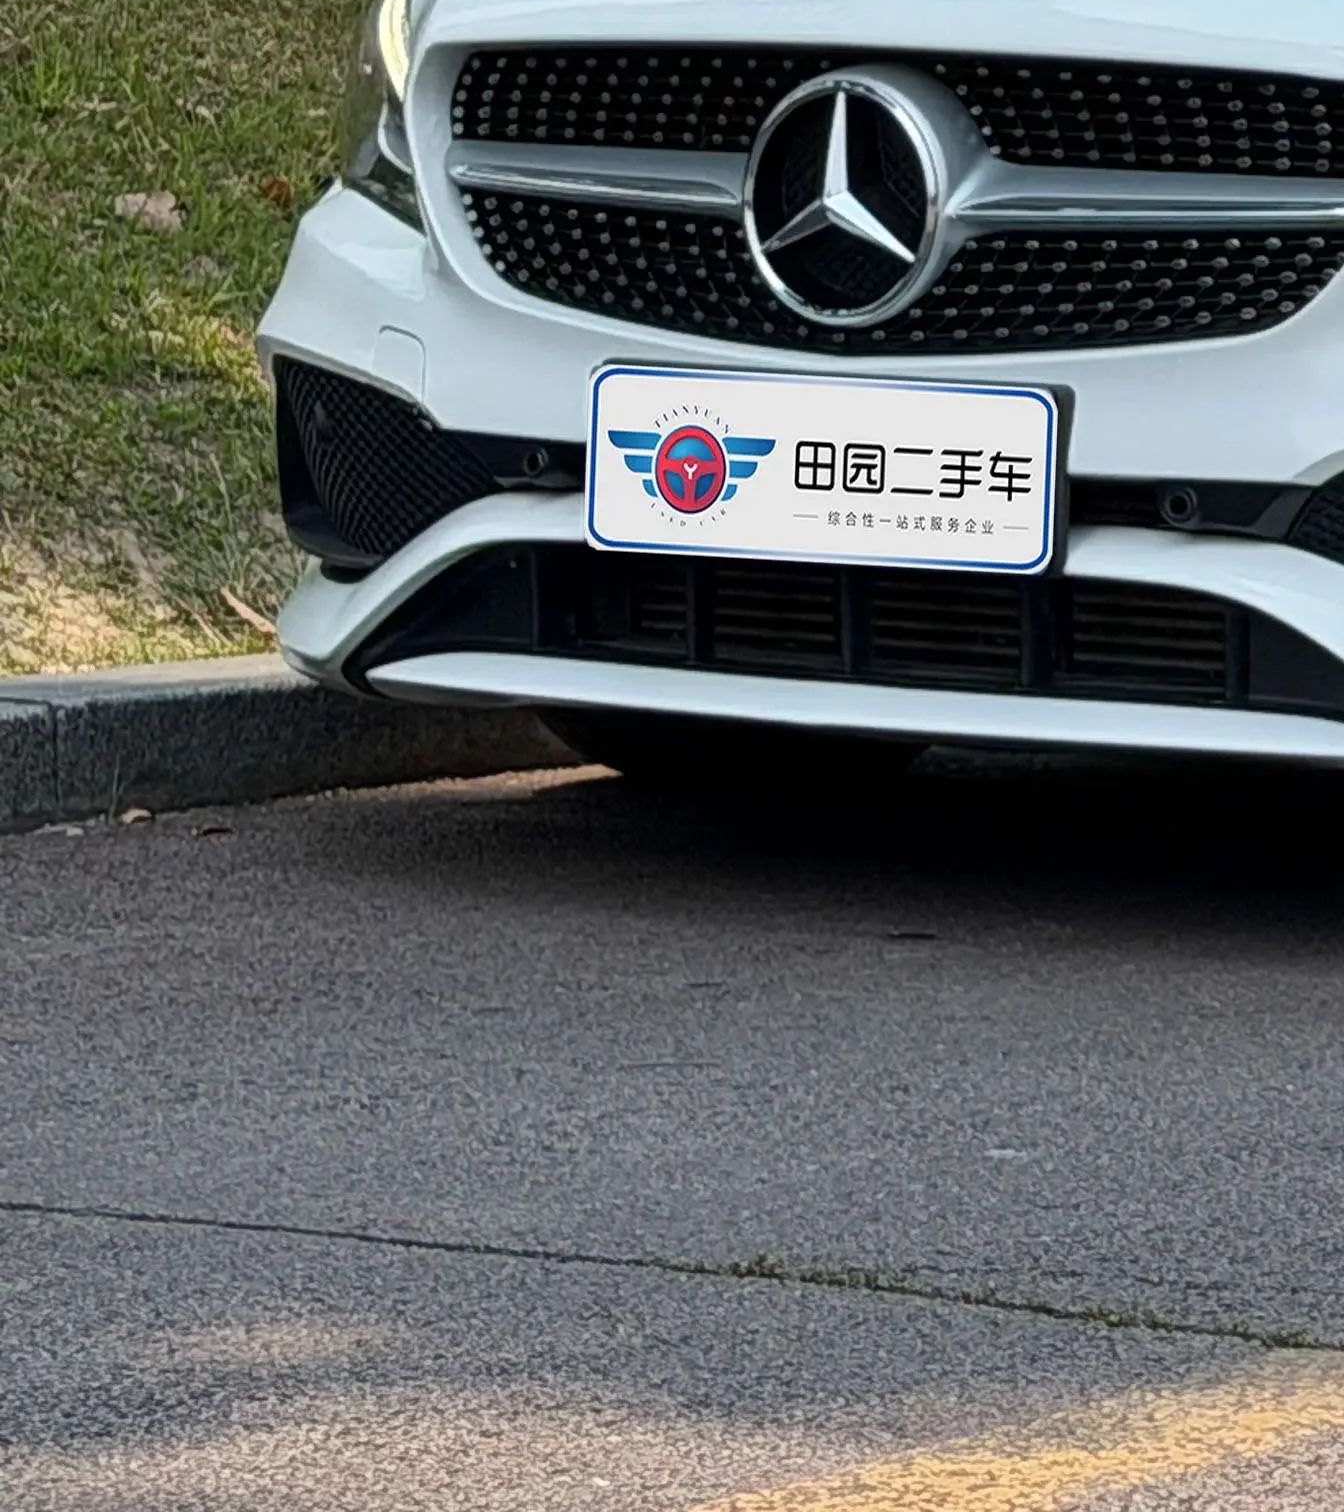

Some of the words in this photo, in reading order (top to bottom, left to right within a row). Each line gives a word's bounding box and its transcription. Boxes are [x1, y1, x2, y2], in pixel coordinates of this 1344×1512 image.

[794, 440, 1033, 502] 田园二手车
[827, 510, 995, 536] 综合性一站式服务企业
